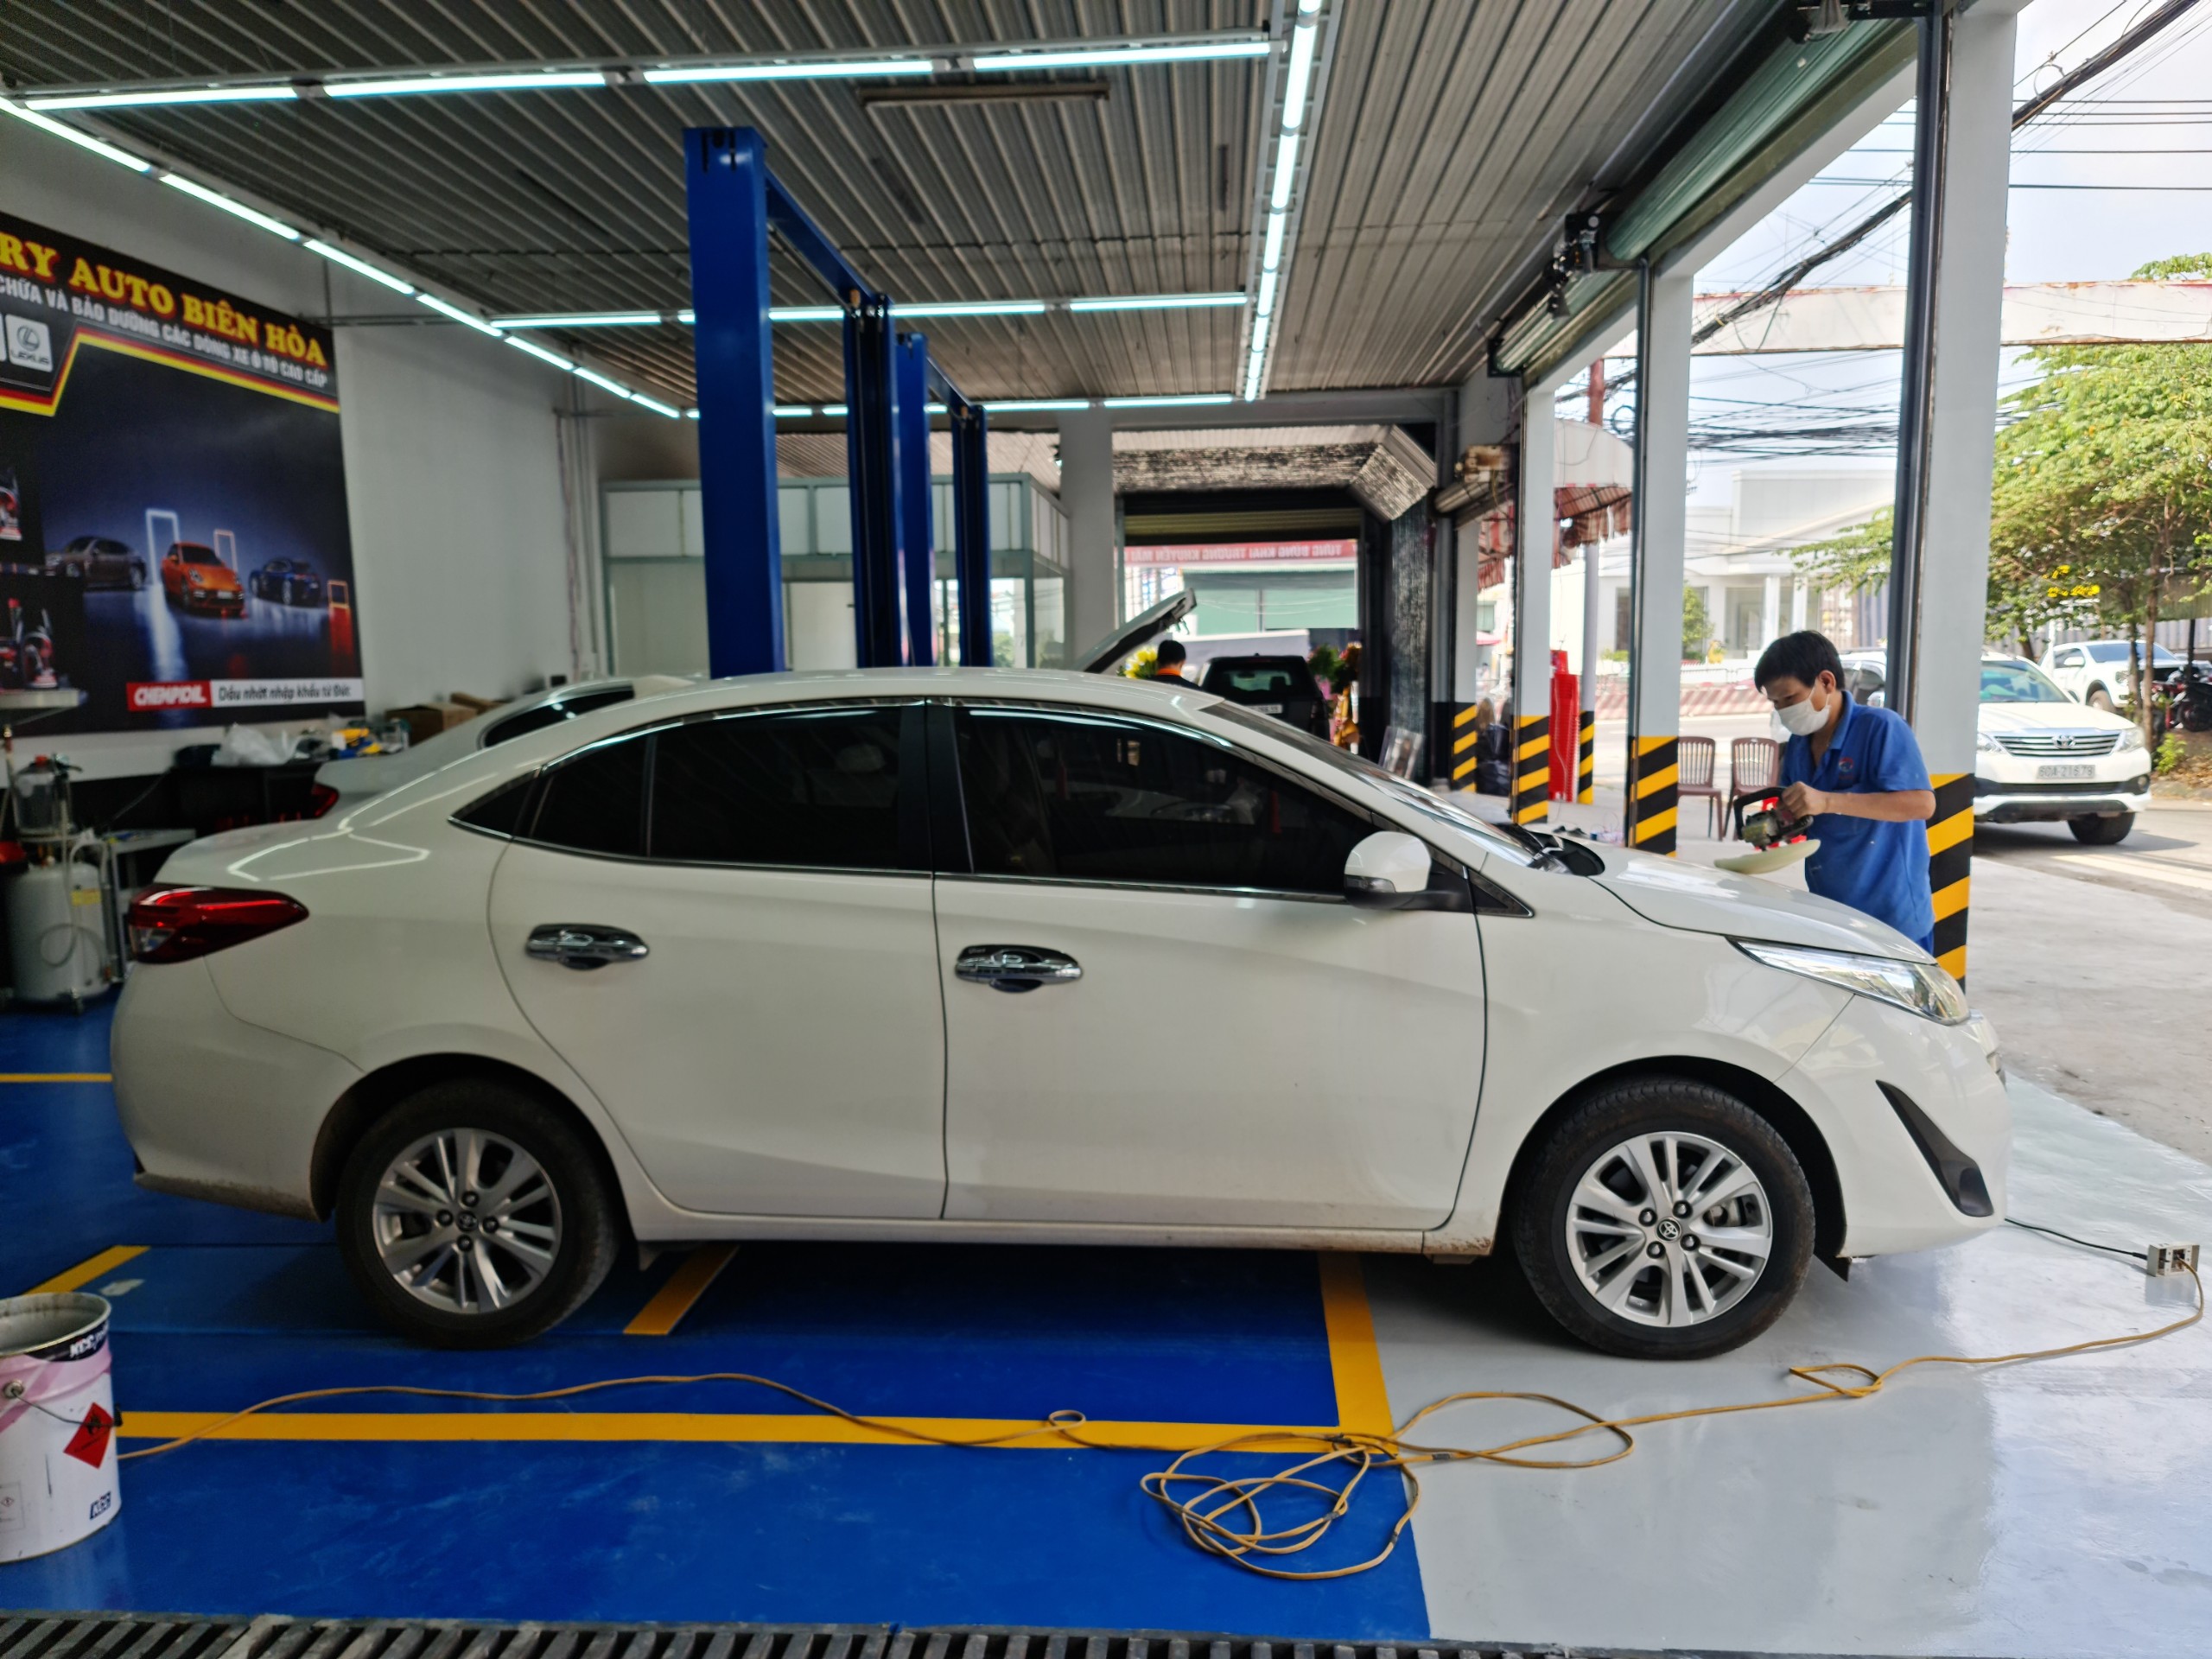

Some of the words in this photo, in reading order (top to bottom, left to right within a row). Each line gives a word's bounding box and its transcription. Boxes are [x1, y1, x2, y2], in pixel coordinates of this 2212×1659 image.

[45, 288, 69, 312] VÀ
[72, 295, 105, 321] BẢO
[69, 257, 175, 315] AUTO
[181, 293, 257, 343] BIÊN
[265, 322, 327, 366] HÒA
[10, 349, 50, 365] LEXUS
